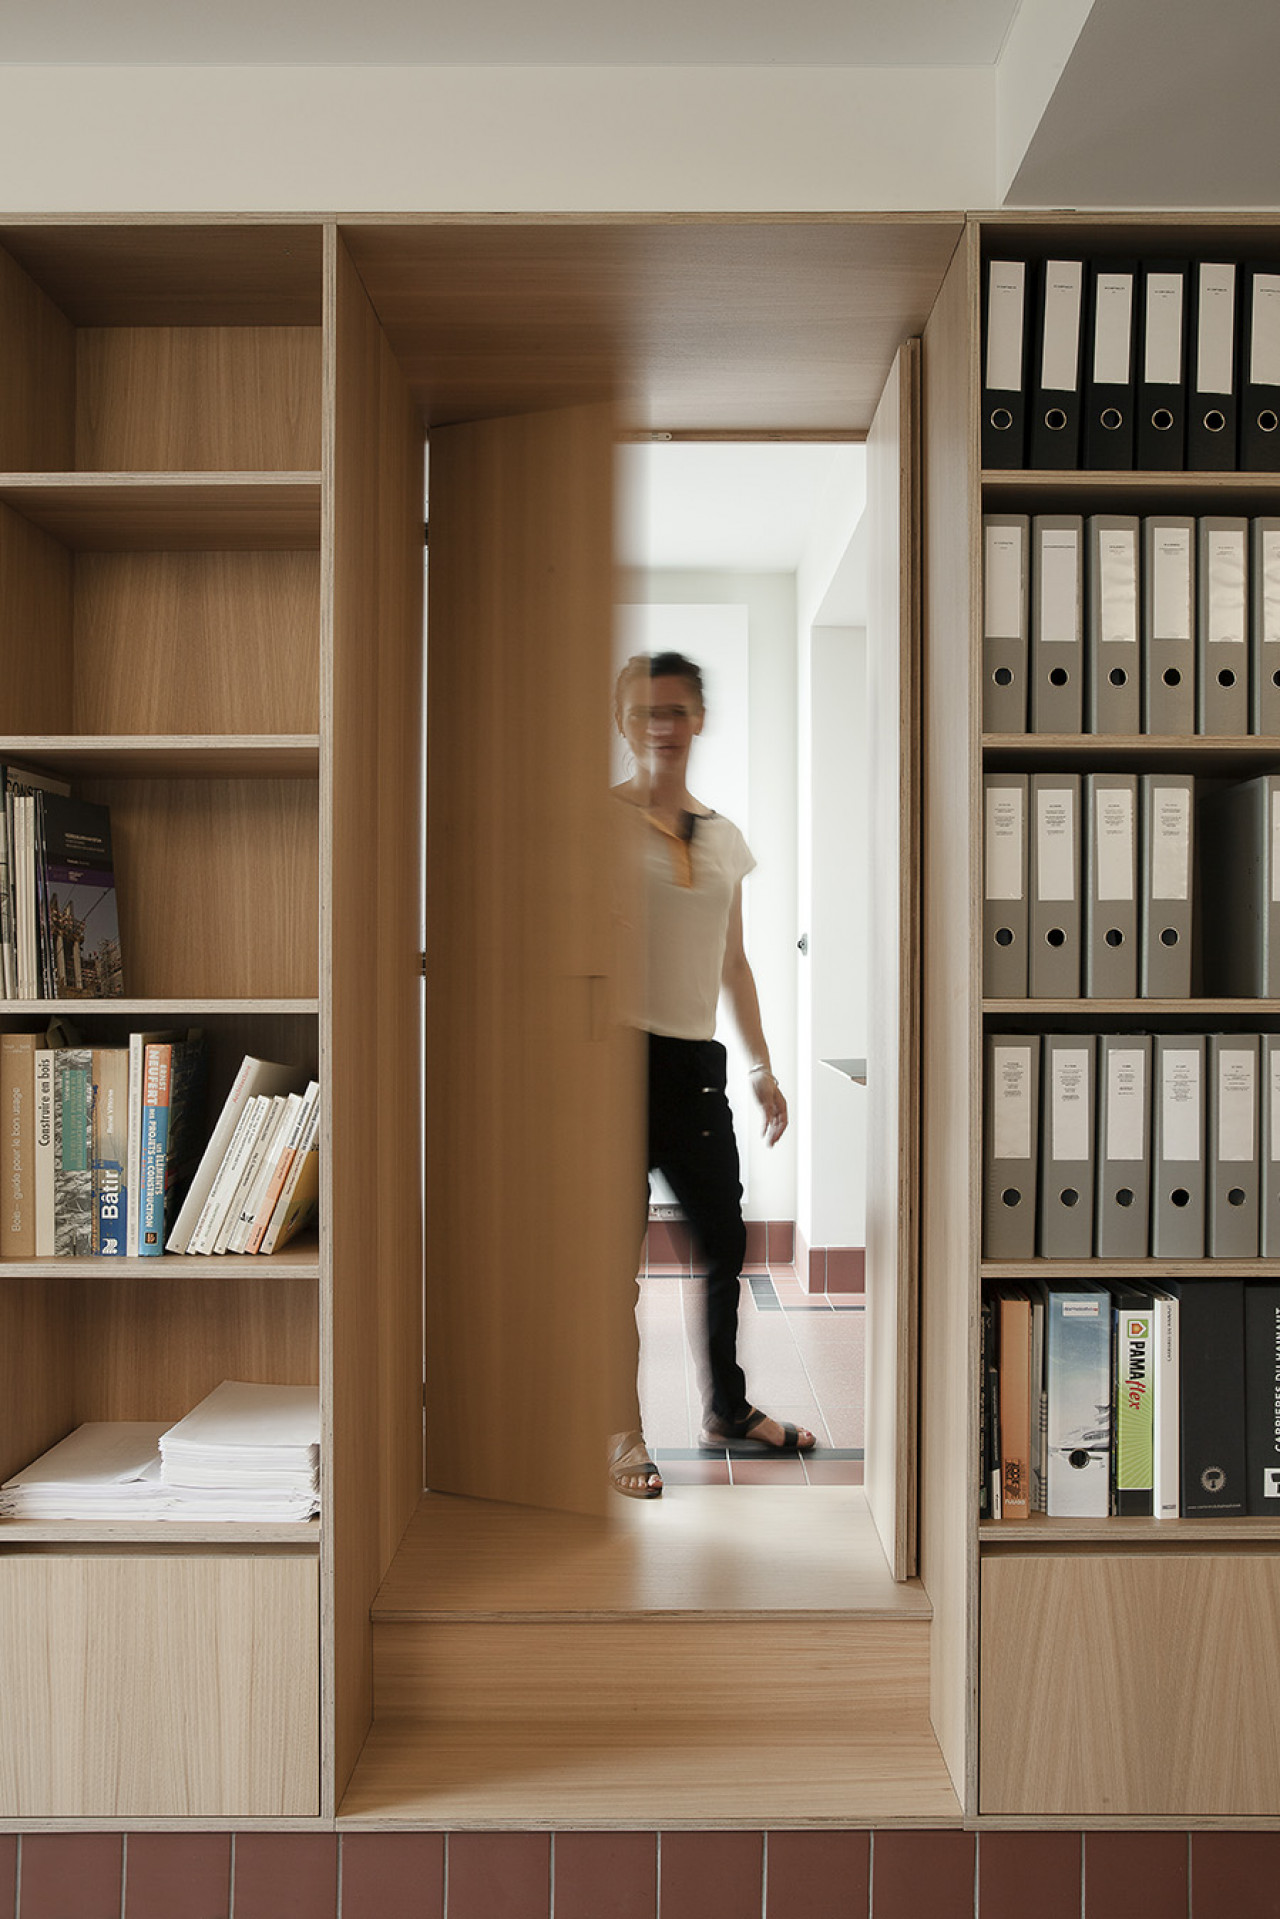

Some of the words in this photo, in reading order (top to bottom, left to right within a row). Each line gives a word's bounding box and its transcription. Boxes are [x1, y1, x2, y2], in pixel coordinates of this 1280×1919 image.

[37, 1059, 50, 1079] bois
[147, 1050, 160, 1105] NEUFERT
[159, 1064, 167, 1091] ERNST
[13, 1087, 23, 1115] usage
[41, 1082, 50, 1093] en
[12, 1118, 20, 1136] bon
[38, 1096, 50, 1147] Construire
[12, 1139, 20, 1147] le
[148, 1120, 156, 1155] PROJETS
[13, 1149, 22, 1171] pour
[11, 1173, 23, 1200] guide
[101, 1170, 118, 1219] Bâtir
[145, 1165, 155, 1227] CONSTRUCTION
[1125, 1341, 1146, 1410] PAMAflex
